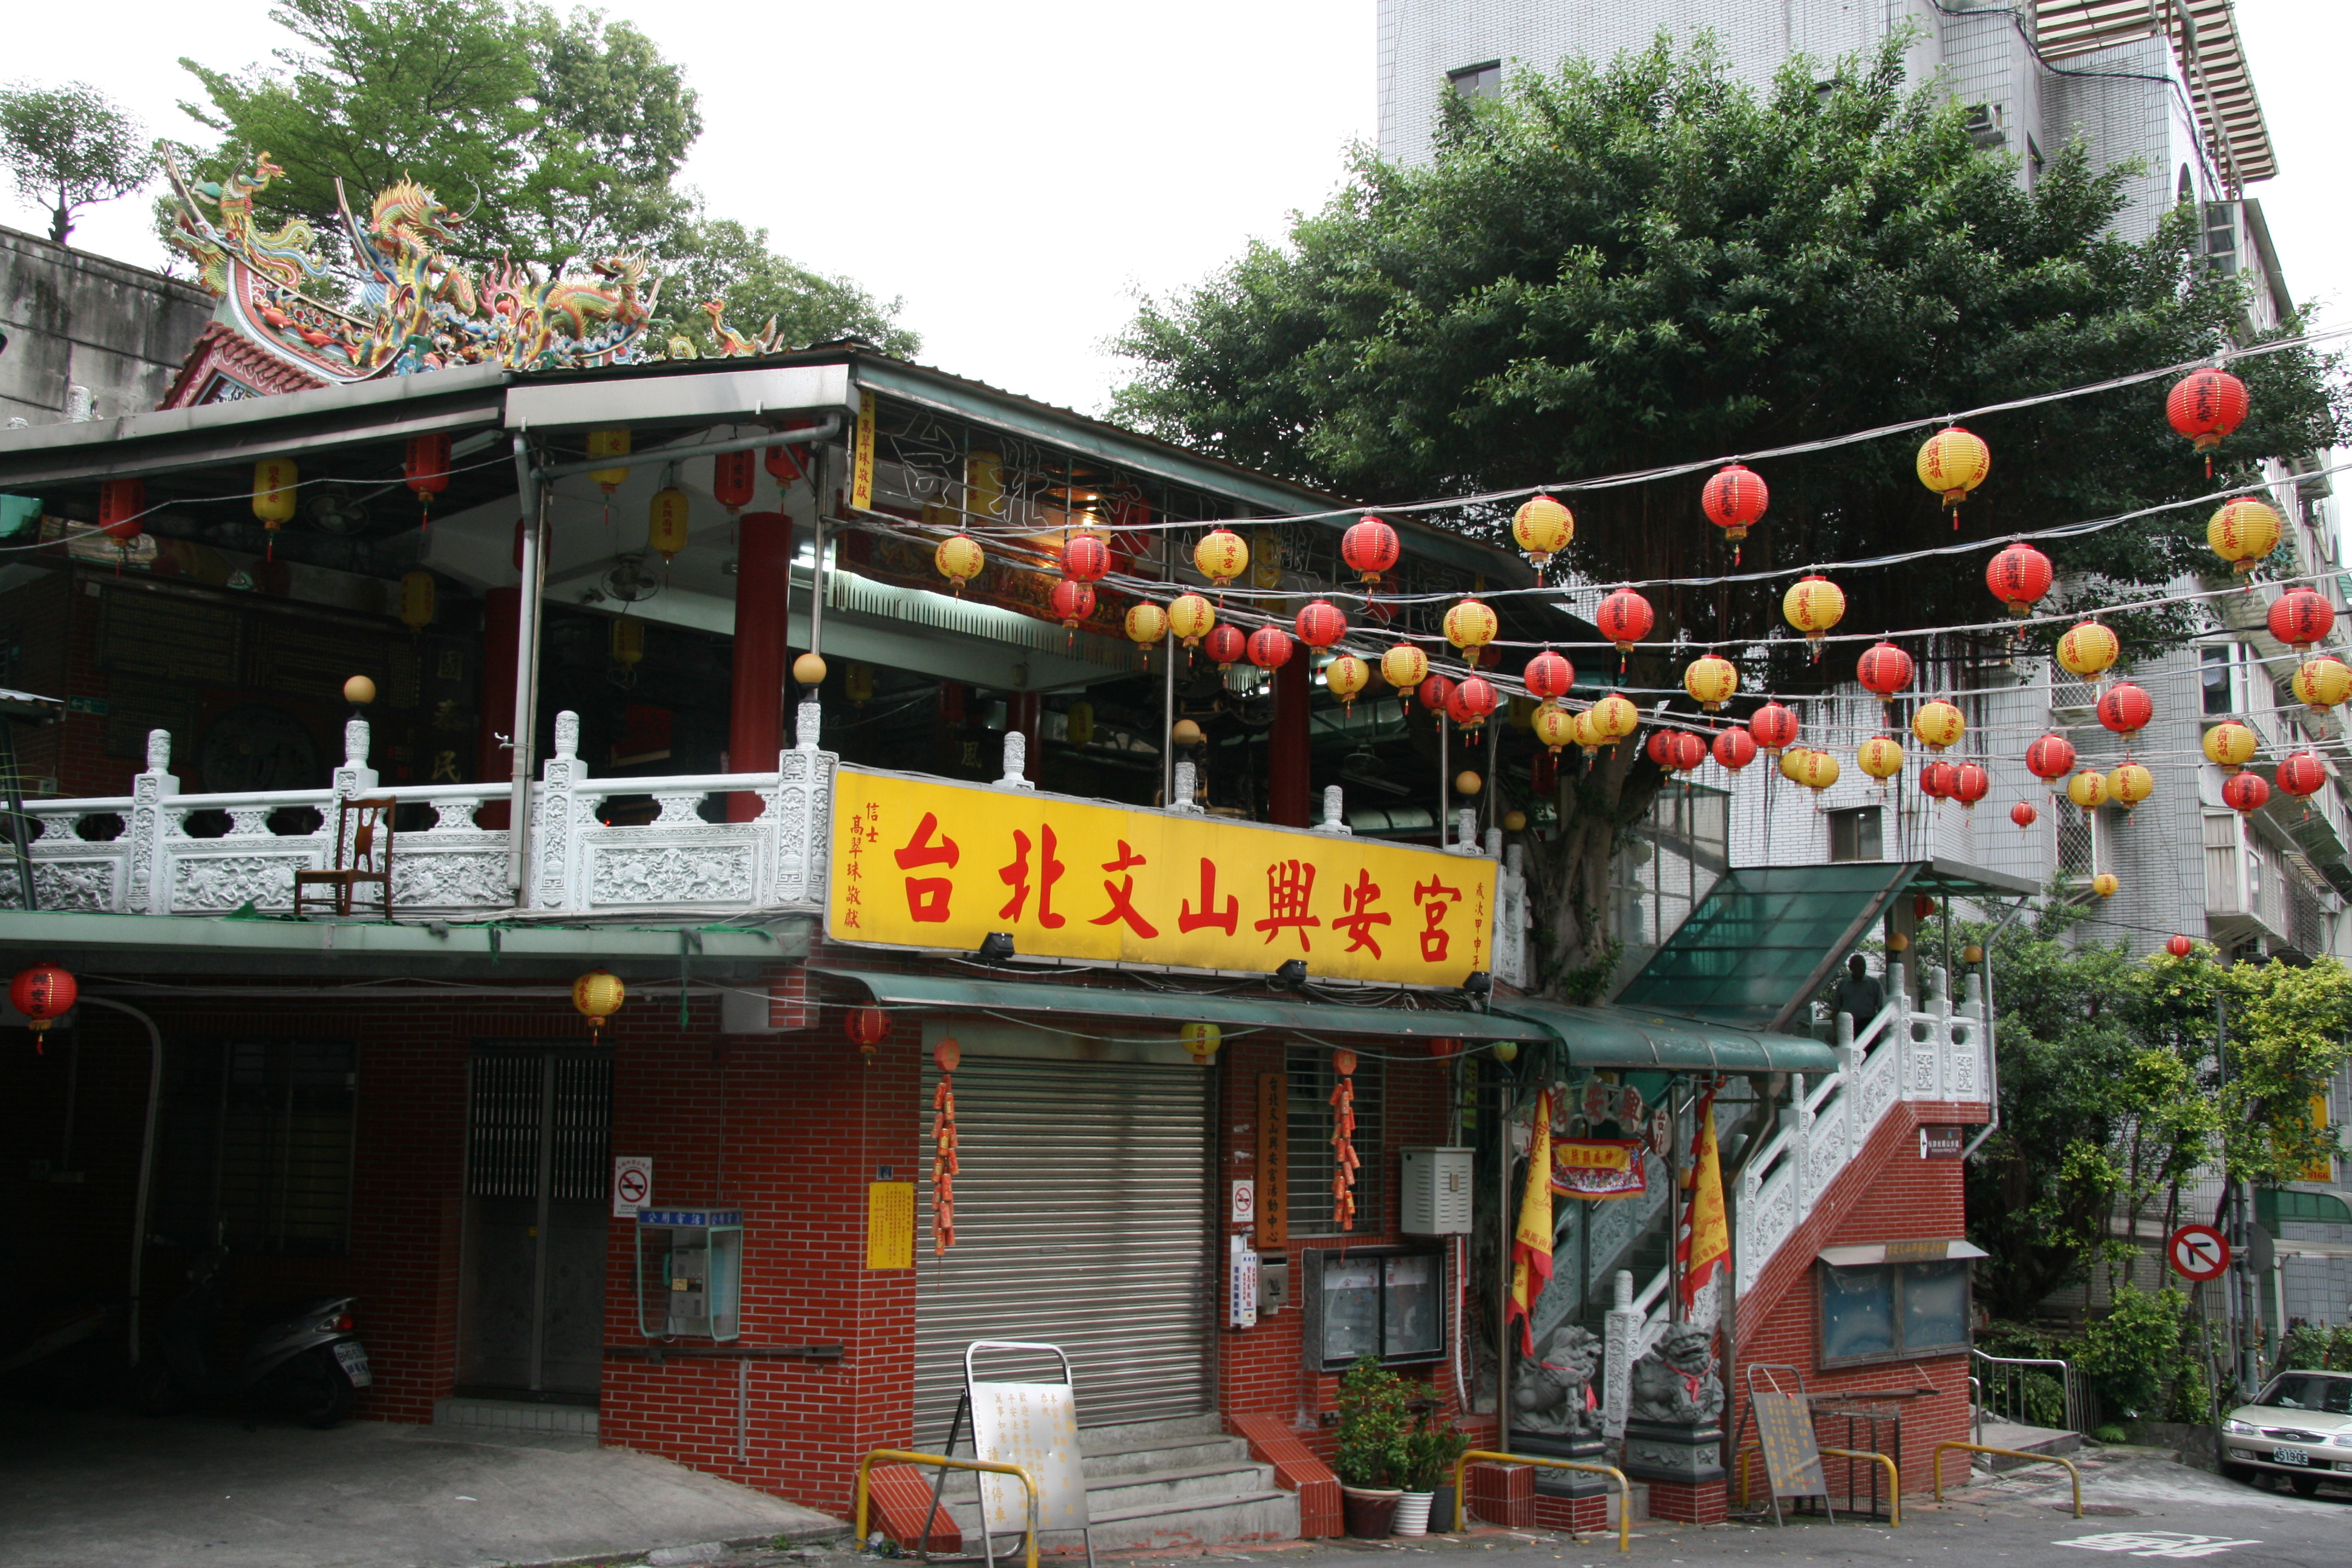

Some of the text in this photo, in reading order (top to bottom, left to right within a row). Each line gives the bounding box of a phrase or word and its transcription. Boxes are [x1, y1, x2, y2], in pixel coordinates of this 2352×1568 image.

[1928, 438, 1943, 478] 風調雨順
[1798, 589, 1812, 626] 國泰民安
[2089, 776, 2099, 802] 國泰民安
[2120, 769, 2132, 799] 國泰民安
[865, 802, 880, 843] 信士
[844, 814, 864, 929] 高翠珠敬獻
[893, 811, 1462, 962] 台北文山興安宮
[1472, 882, 1485, 971] 歲次甲申年
[1266, 1077, 1281, 1243] 台北文山興安宮活動中心
[647, 1212, 702, 1226] 公用電話
